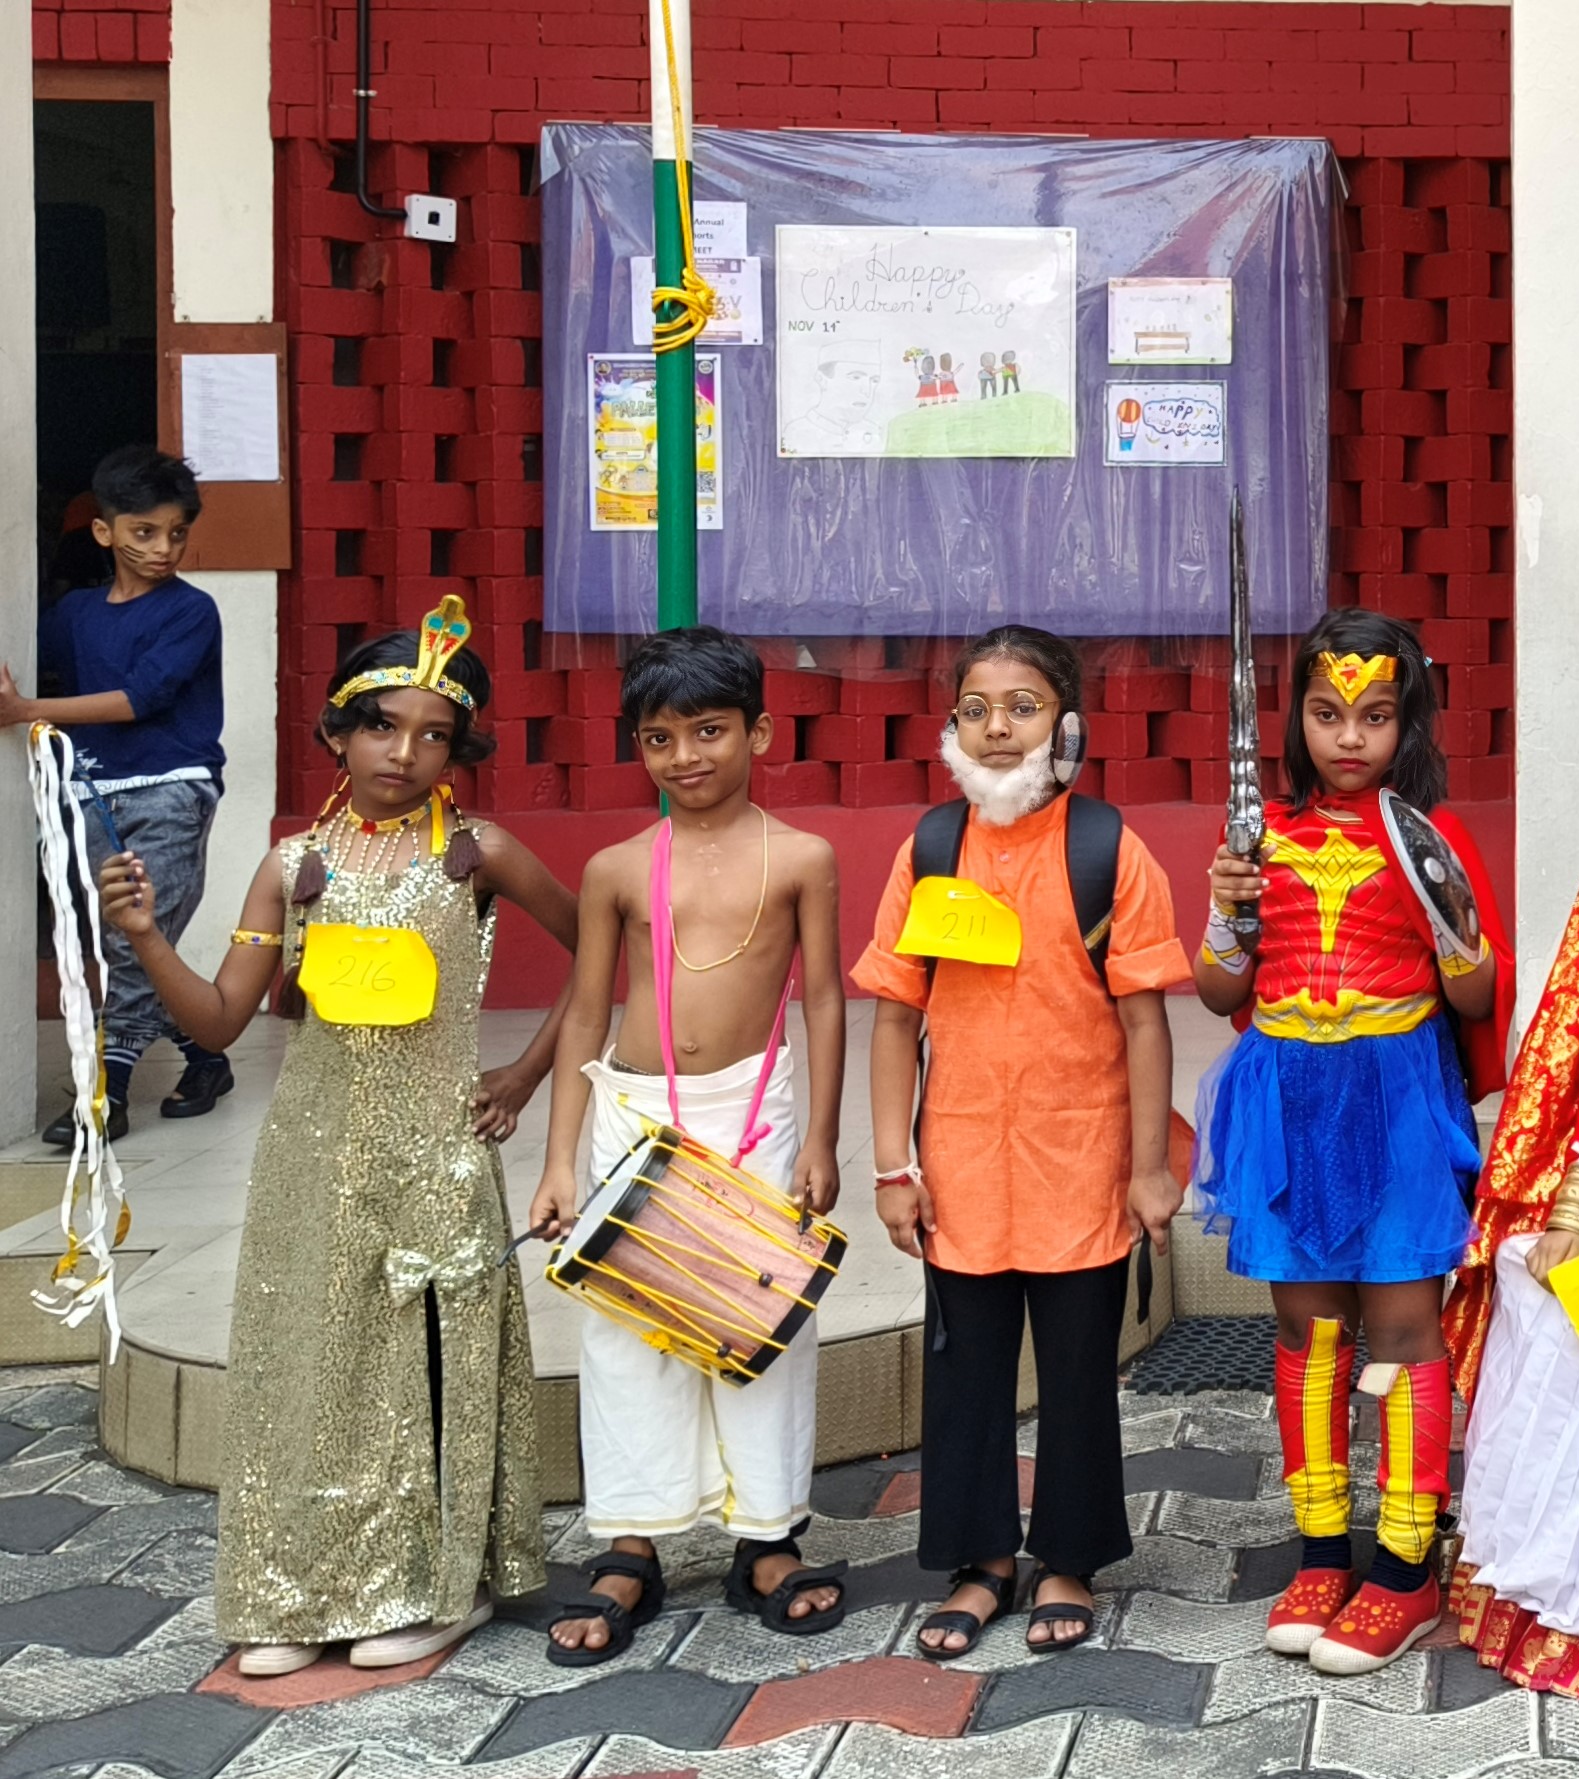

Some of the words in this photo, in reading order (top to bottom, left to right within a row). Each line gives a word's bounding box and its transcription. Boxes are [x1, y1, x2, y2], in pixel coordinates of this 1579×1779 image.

[694, 218, 724, 226] Annual
[866, 243, 966, 299] Happy
[955, 281, 1015, 328] Day
[788, 320, 815, 332] NOV
[1159, 404, 1203, 420] HAPPY
[942, 912, 986, 940] 211
[328, 955, 396, 992] 216
